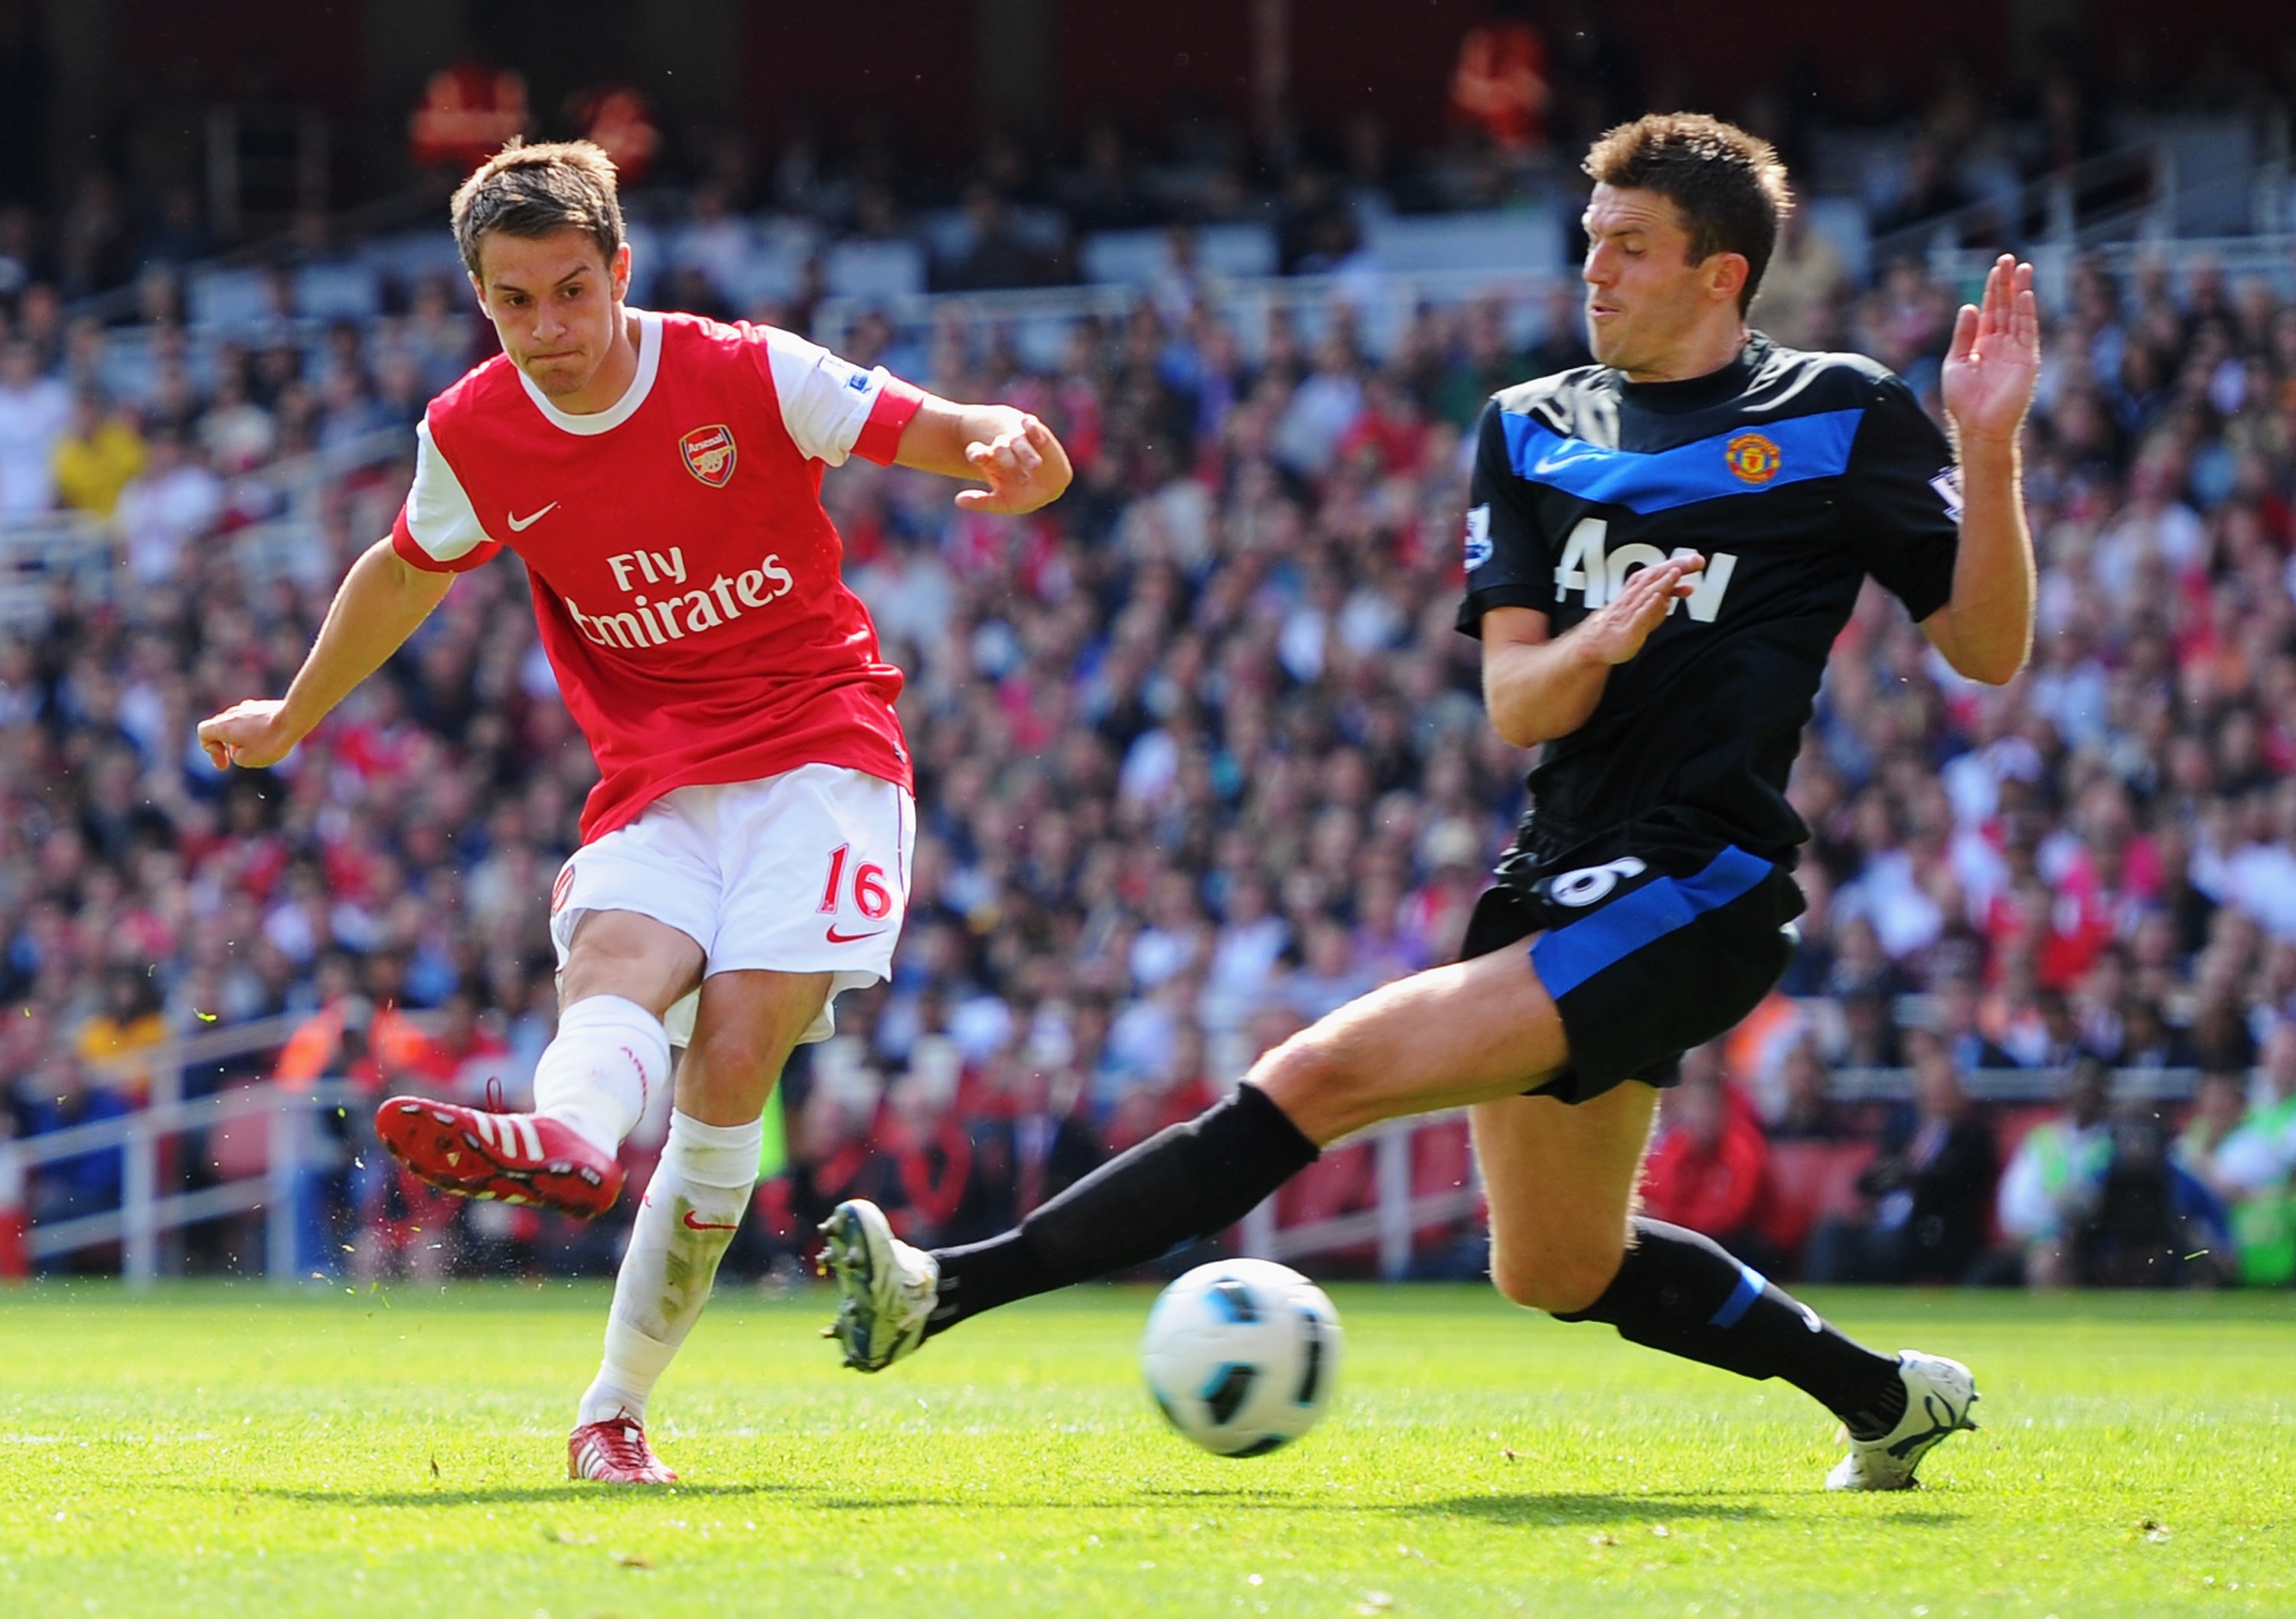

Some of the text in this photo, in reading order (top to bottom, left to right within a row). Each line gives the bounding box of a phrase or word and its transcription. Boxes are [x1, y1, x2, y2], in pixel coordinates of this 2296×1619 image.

[688, 433, 724, 453] Arsenal
[607, 546, 687, 591] Fly
[565, 554, 794, 649] Emirates
[815, 842, 892, 922] 16
